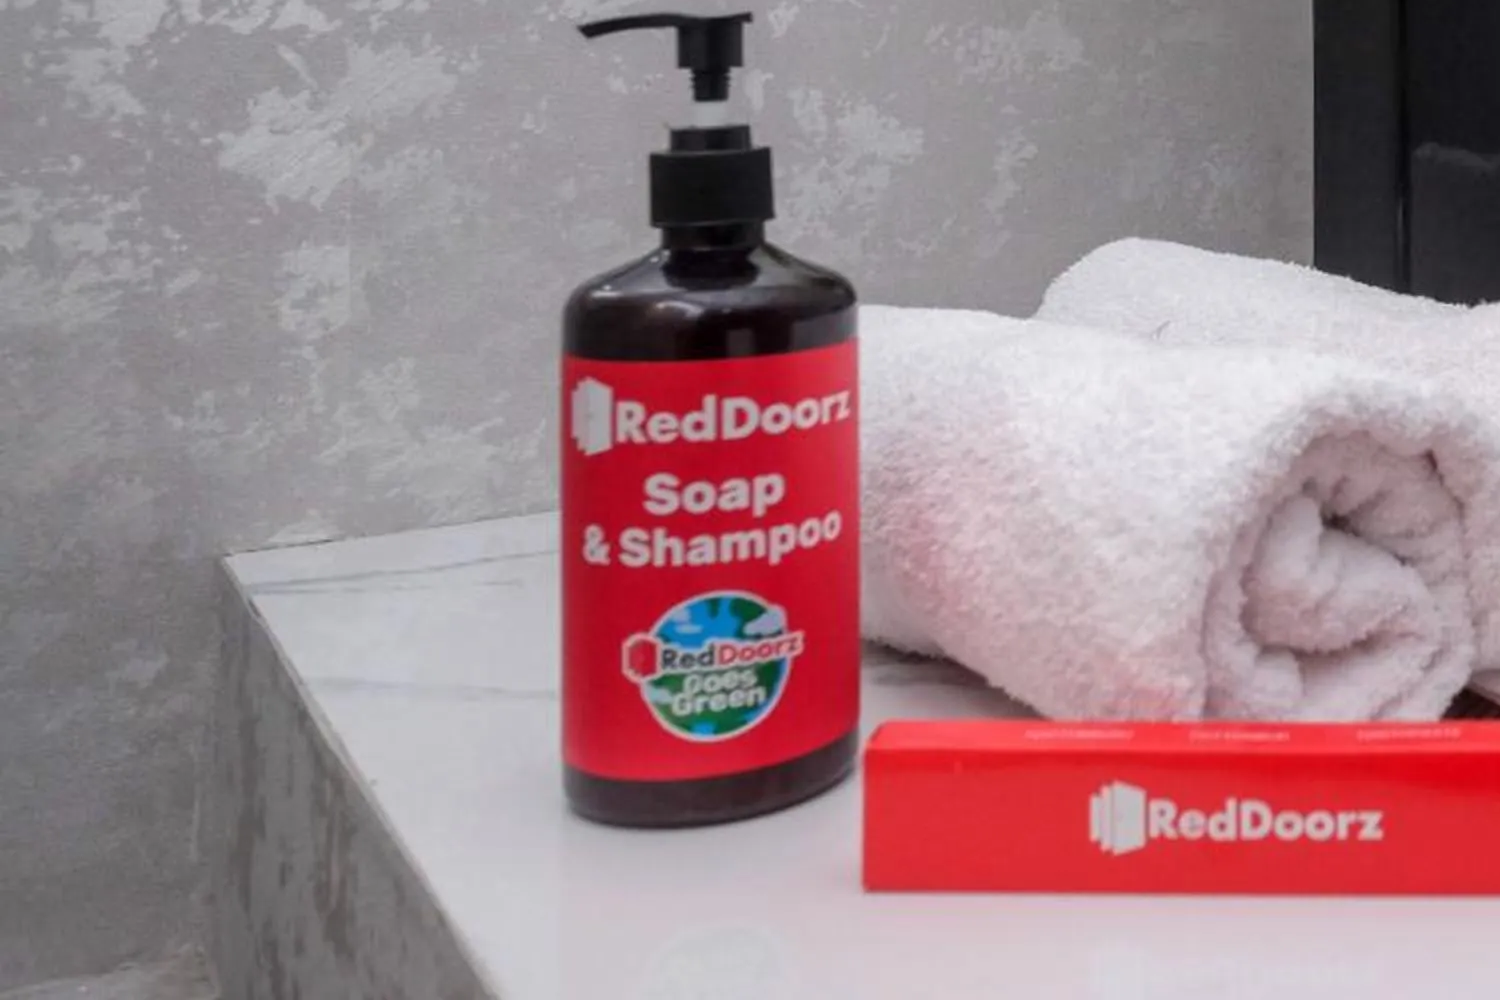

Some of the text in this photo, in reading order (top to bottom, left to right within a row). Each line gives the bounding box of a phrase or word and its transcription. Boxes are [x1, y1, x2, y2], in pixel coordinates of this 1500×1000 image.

[616, 391, 851, 445] RedDoorz
[643, 472, 786, 518] Soap
[583, 511, 842, 567] & Shampoo
[662, 636, 799, 670] RedDoorz
[671, 685, 767, 717] Green
[682, 668, 758, 695] Goes
[1148, 797, 1384, 842] RedDoorz
